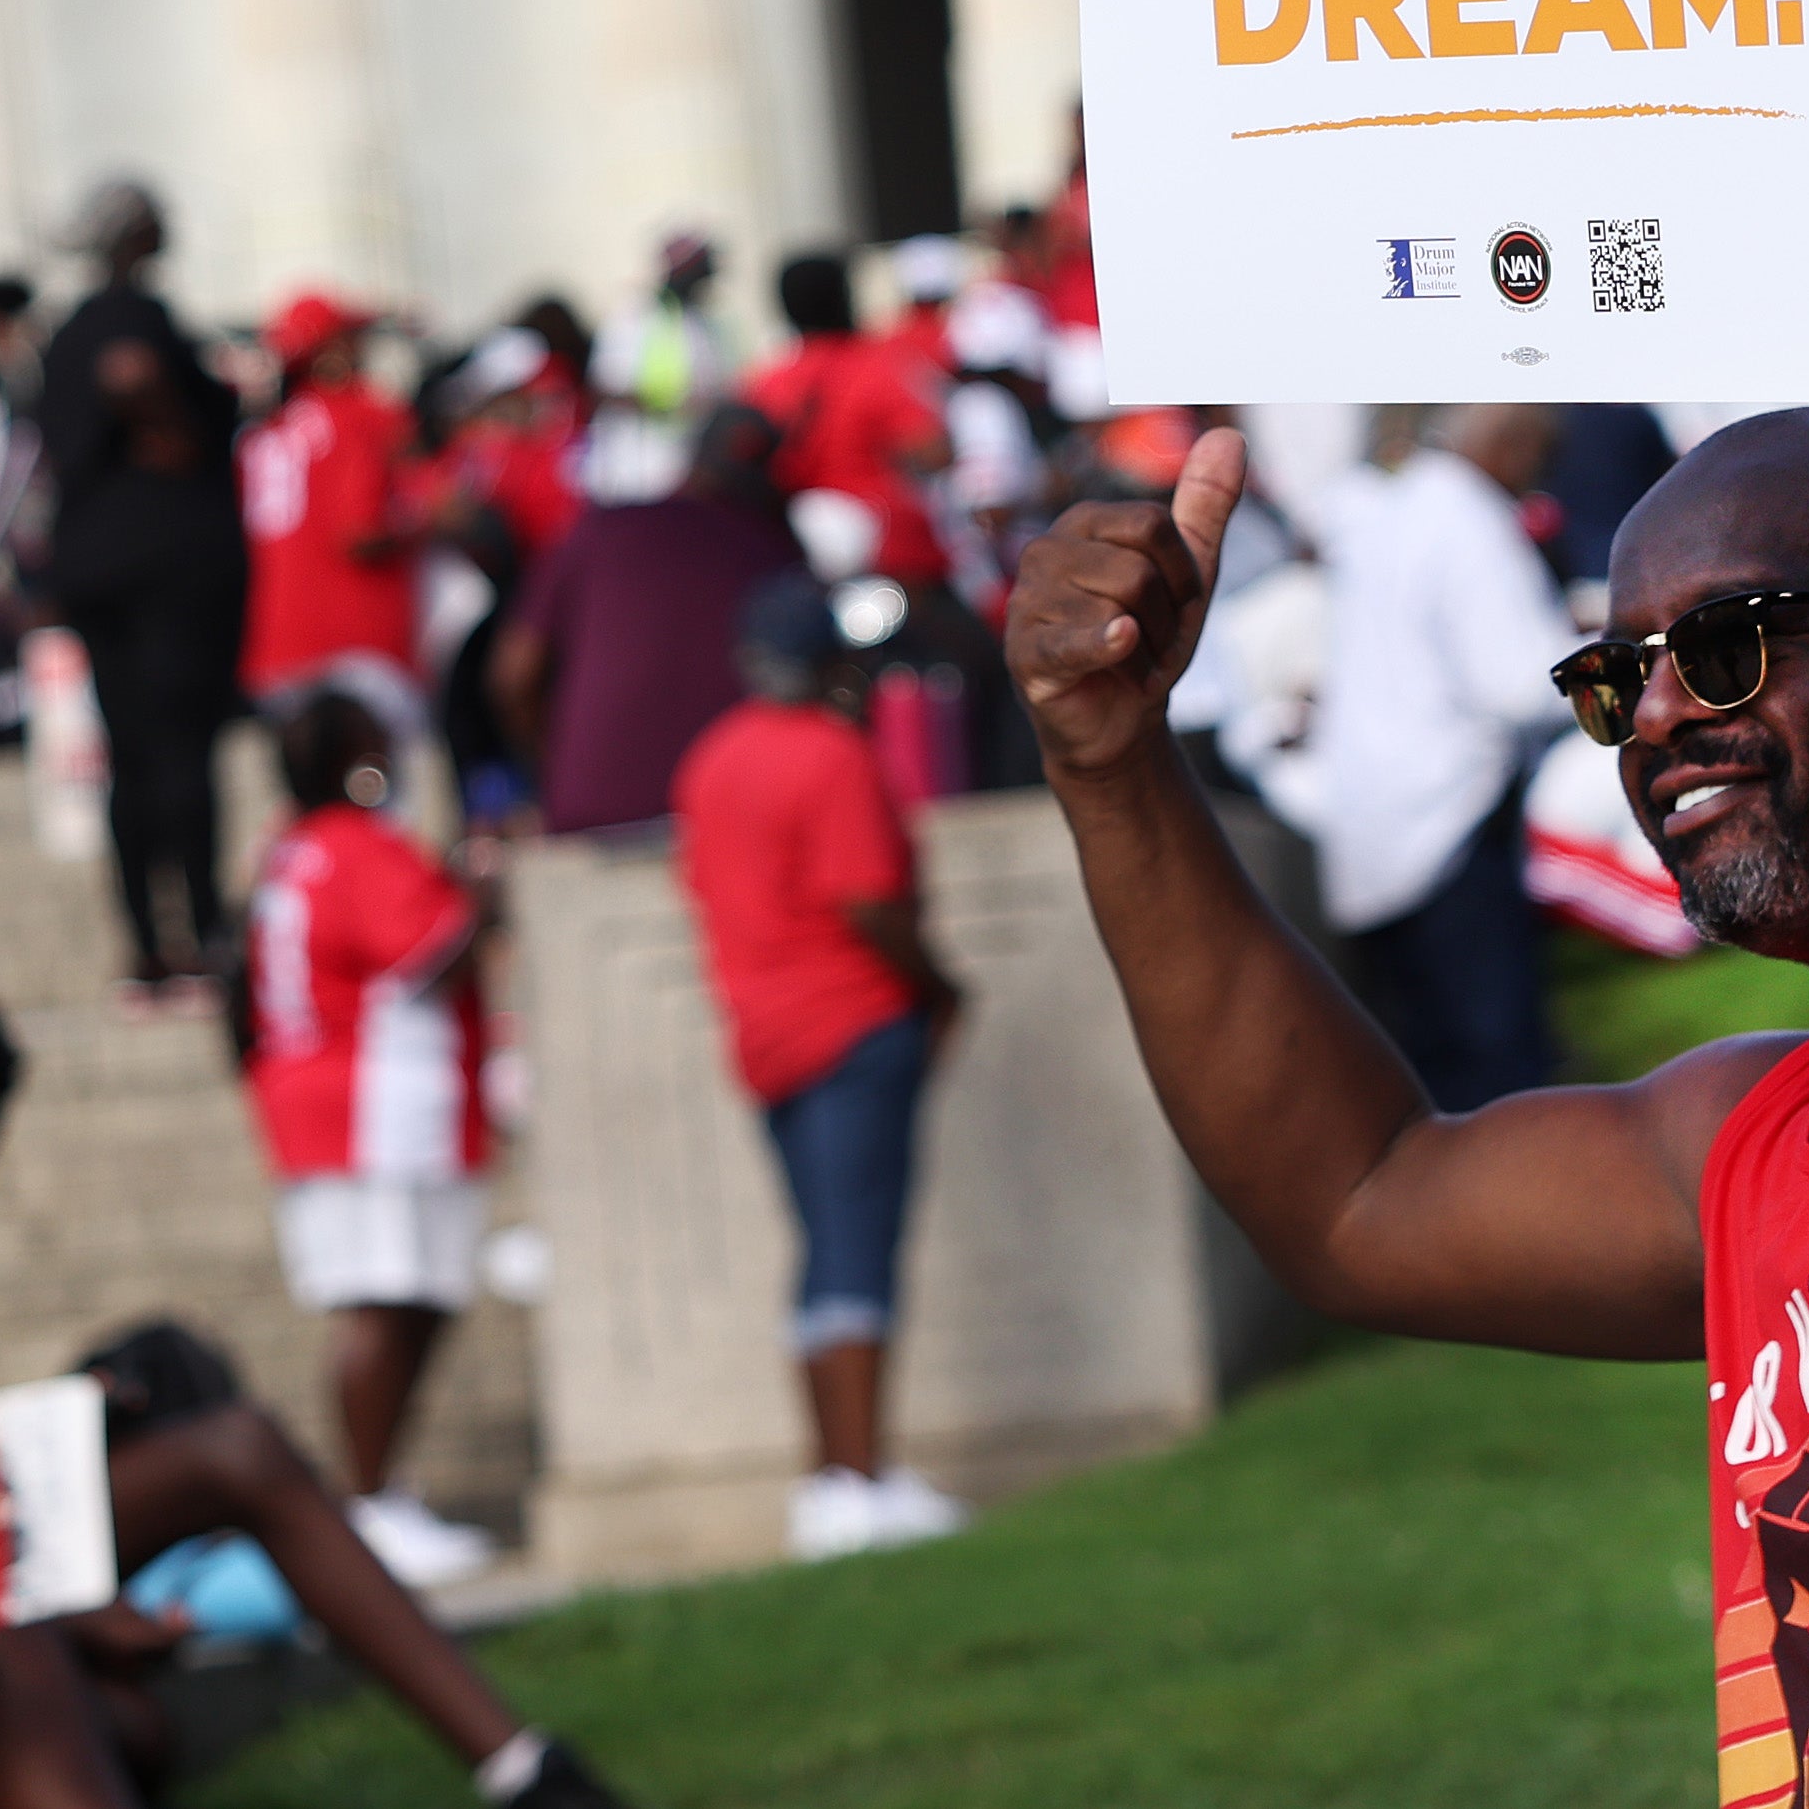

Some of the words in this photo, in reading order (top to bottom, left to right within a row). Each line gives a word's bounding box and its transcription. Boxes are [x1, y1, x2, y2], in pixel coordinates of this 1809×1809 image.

[1485, 226, 1505, 254] NATIONAL
[1506, 221, 1528, 229] ACTION
[1529, 225, 1553, 253] NETWORK
[1413, 245, 1455, 260] Drum
[1415, 261, 1456, 278] Major
[1498, 254, 1543, 281] NAN
[1416, 280, 1457, 290] Institute
